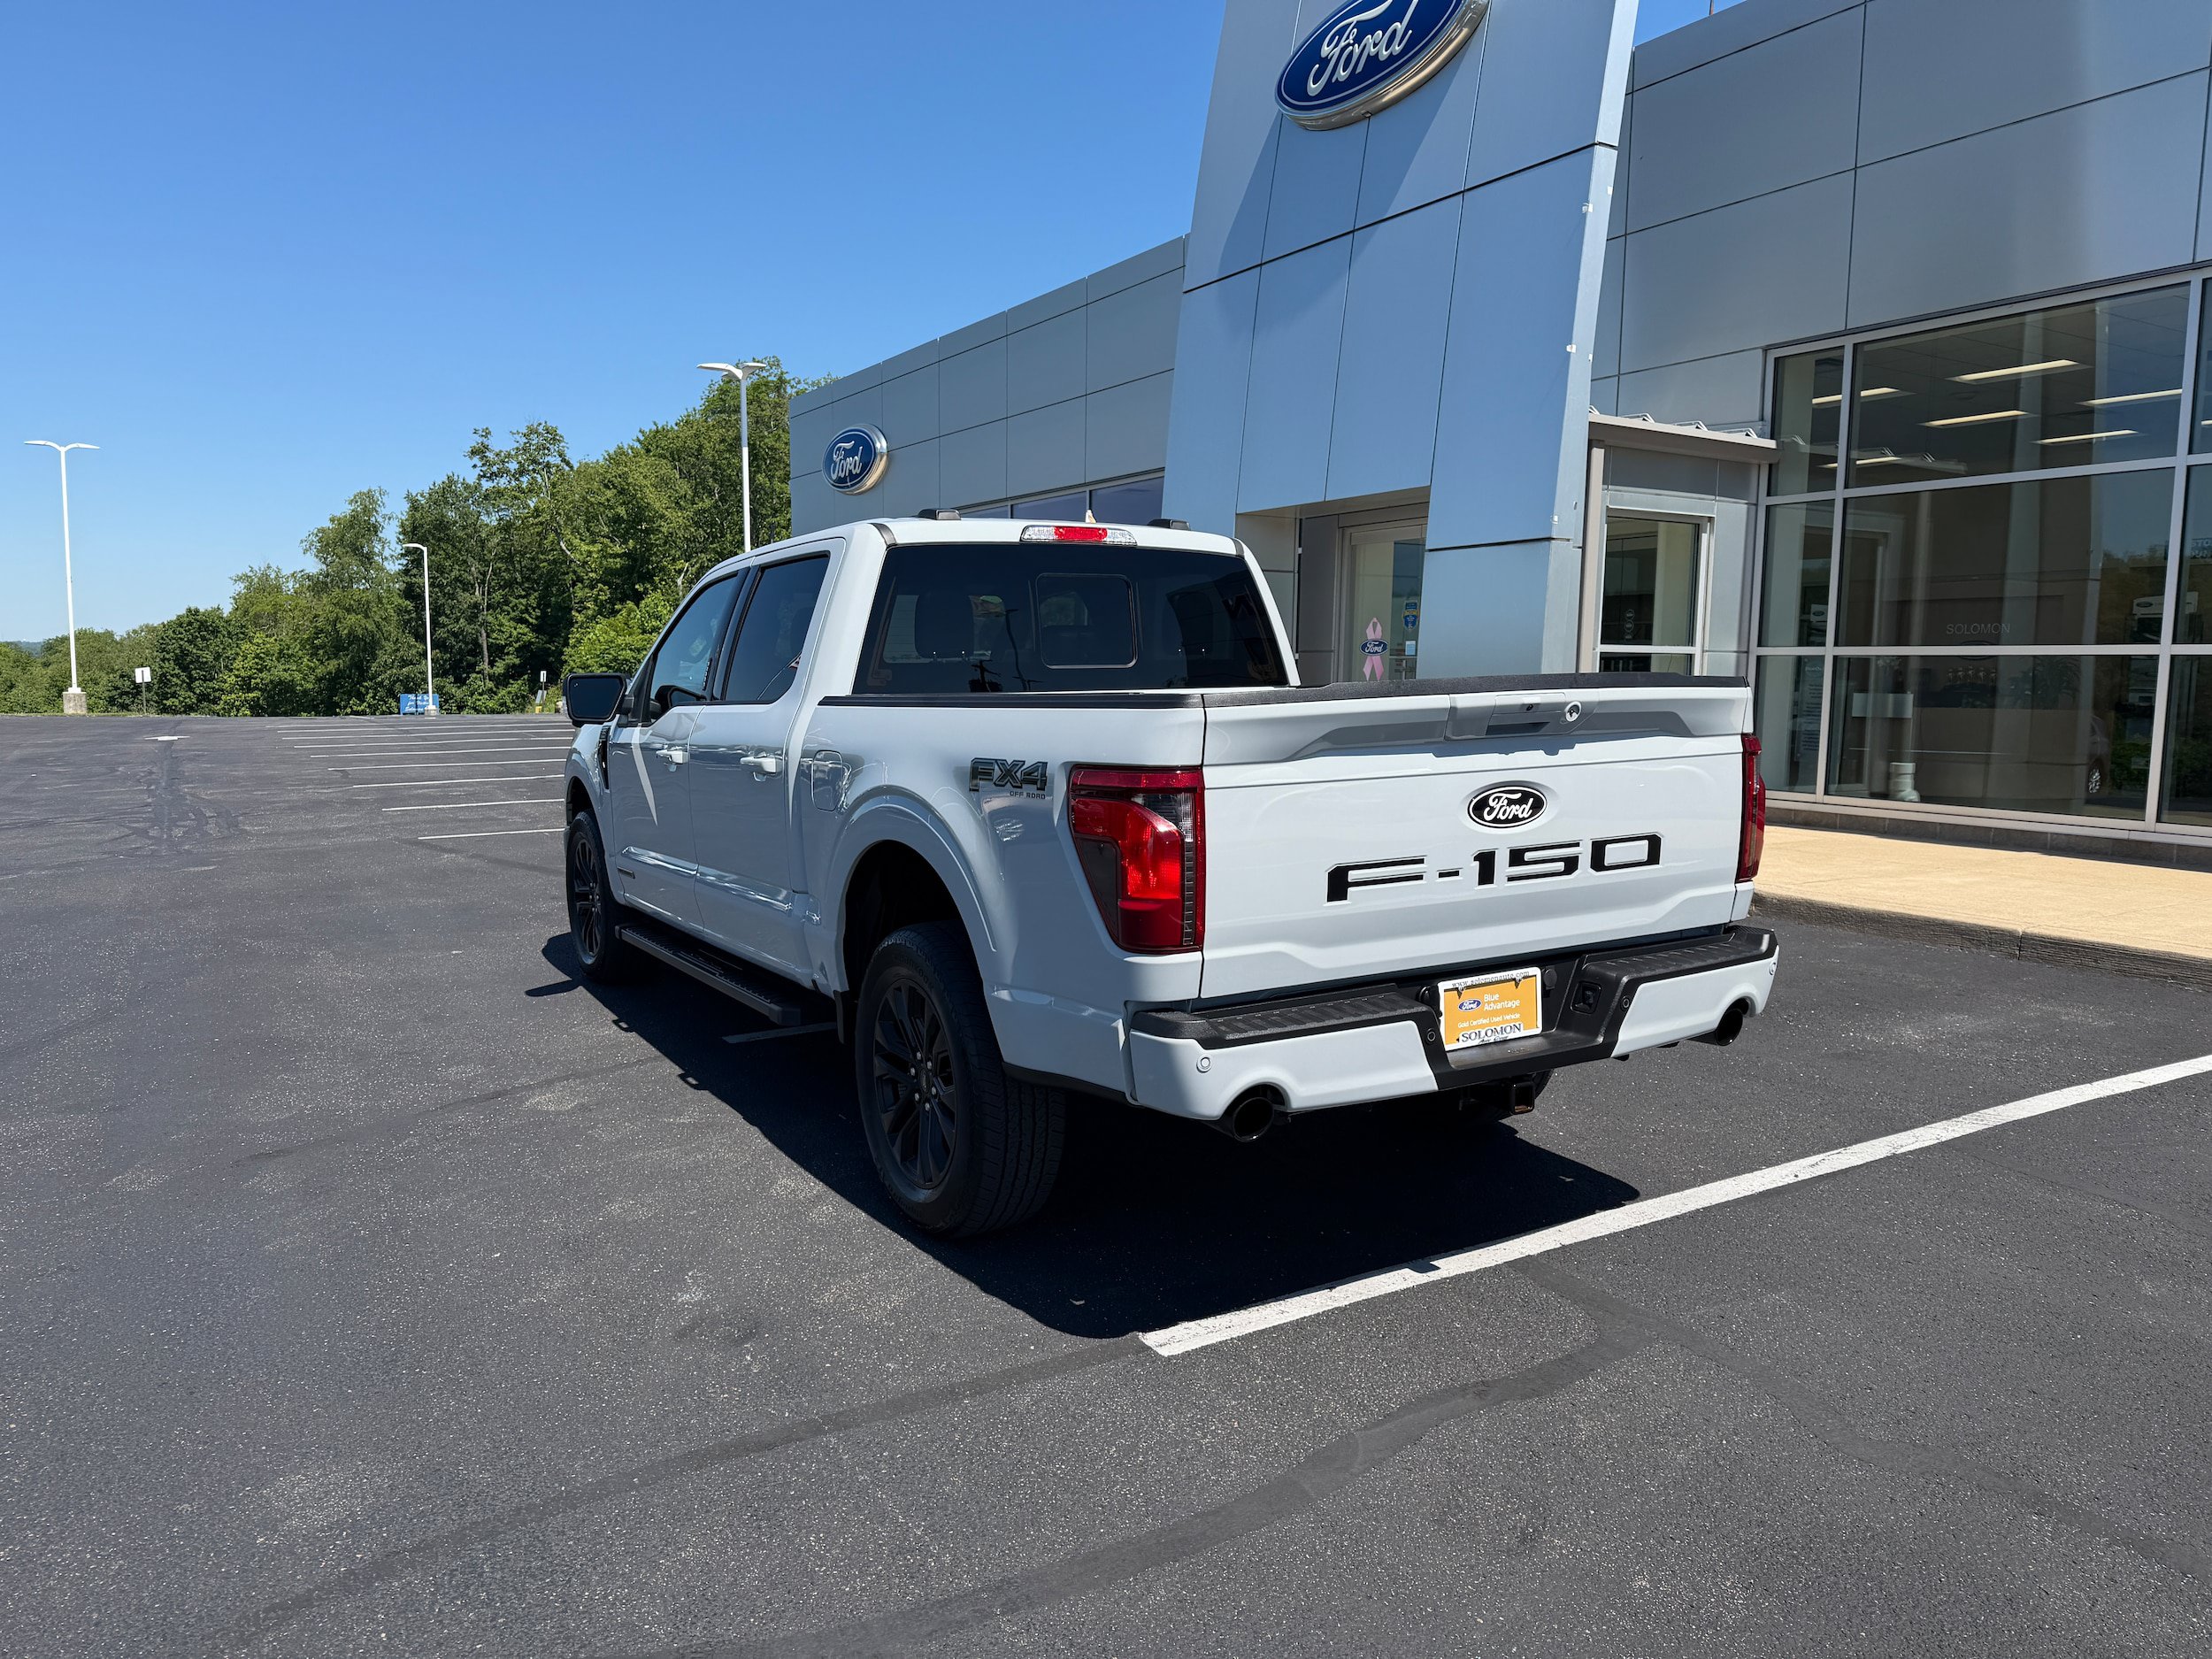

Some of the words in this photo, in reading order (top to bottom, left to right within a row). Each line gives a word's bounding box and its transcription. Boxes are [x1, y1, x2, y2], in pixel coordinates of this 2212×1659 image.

[1307, 0, 1417, 96] Ford
[831, 441, 863, 480] Ford
[1946, 623, 2010, 635] SOLOMON
[1365, 641, 1384, 653] Ford
[969, 757, 1048, 791] FX4
[1483, 791, 1533, 821] Ford
[1326, 833, 1662, 903] F-150
[1452, 971, 1530, 987] www.solomonauto.com
[1462, 1000, 1478, 1010] Ford
[1484, 993, 1500, 1002] Blue
[1484, 999, 1521, 1011] Advantage
[1470, 1018, 1490, 1027] Certified
[1490, 1015, 1503, 1024] Used
[1461, 1023, 1522, 1043] SOLOMON
